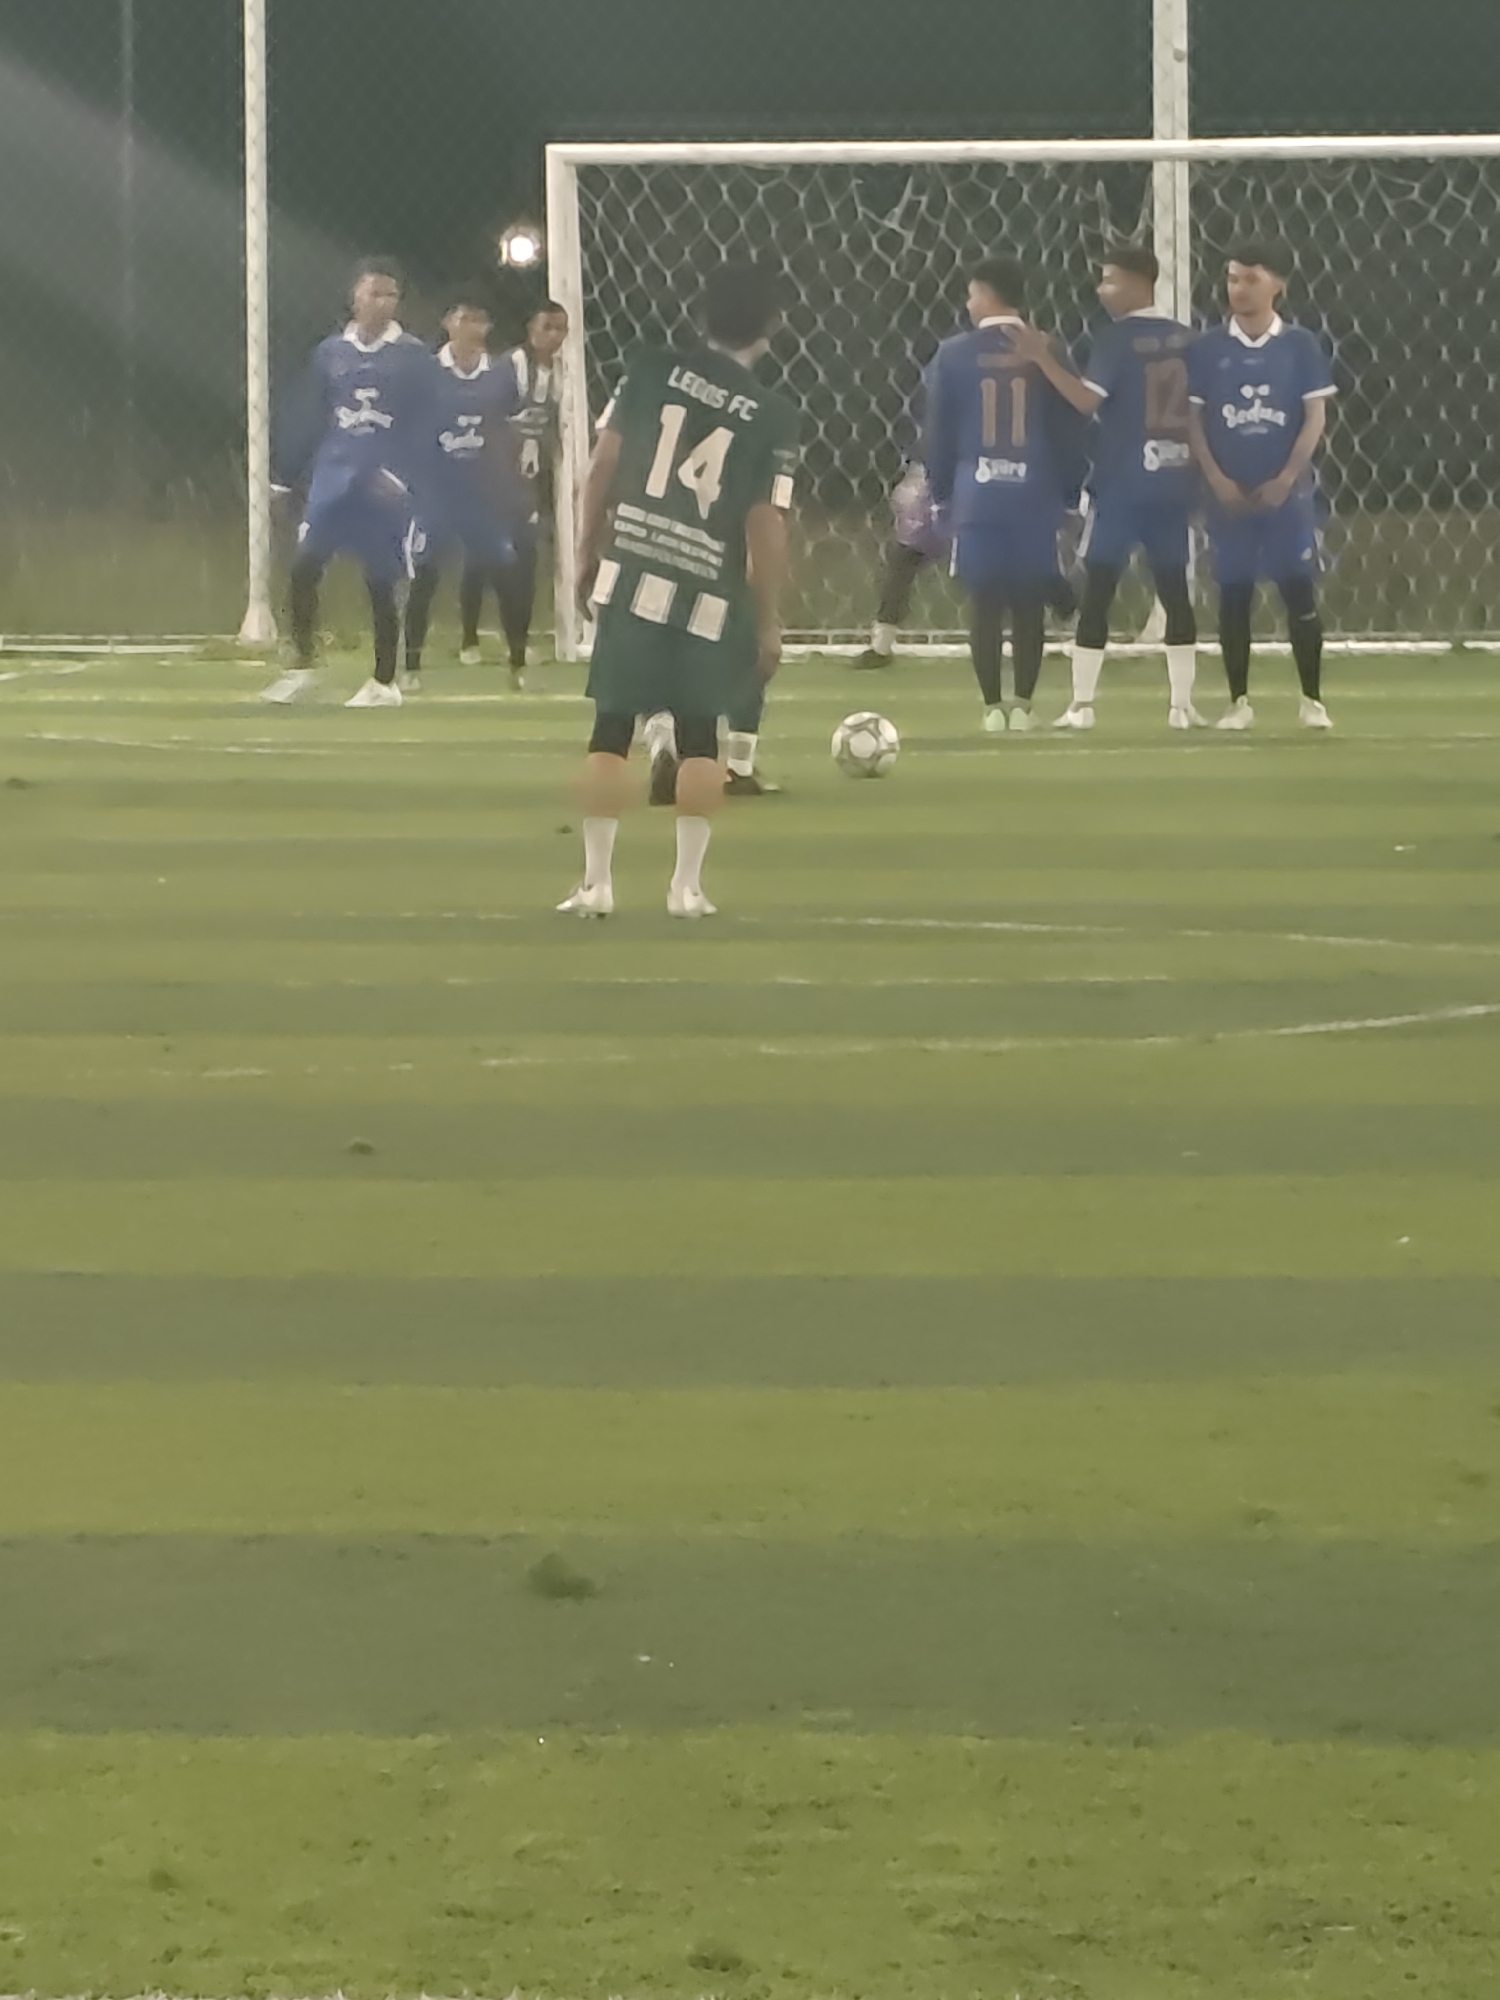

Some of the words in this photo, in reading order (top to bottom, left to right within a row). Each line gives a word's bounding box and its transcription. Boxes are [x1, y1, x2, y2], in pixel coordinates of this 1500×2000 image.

[728, 395, 758, 421] FC
[980, 379, 1027, 447] 11
[646, 404, 734, 518] 14
